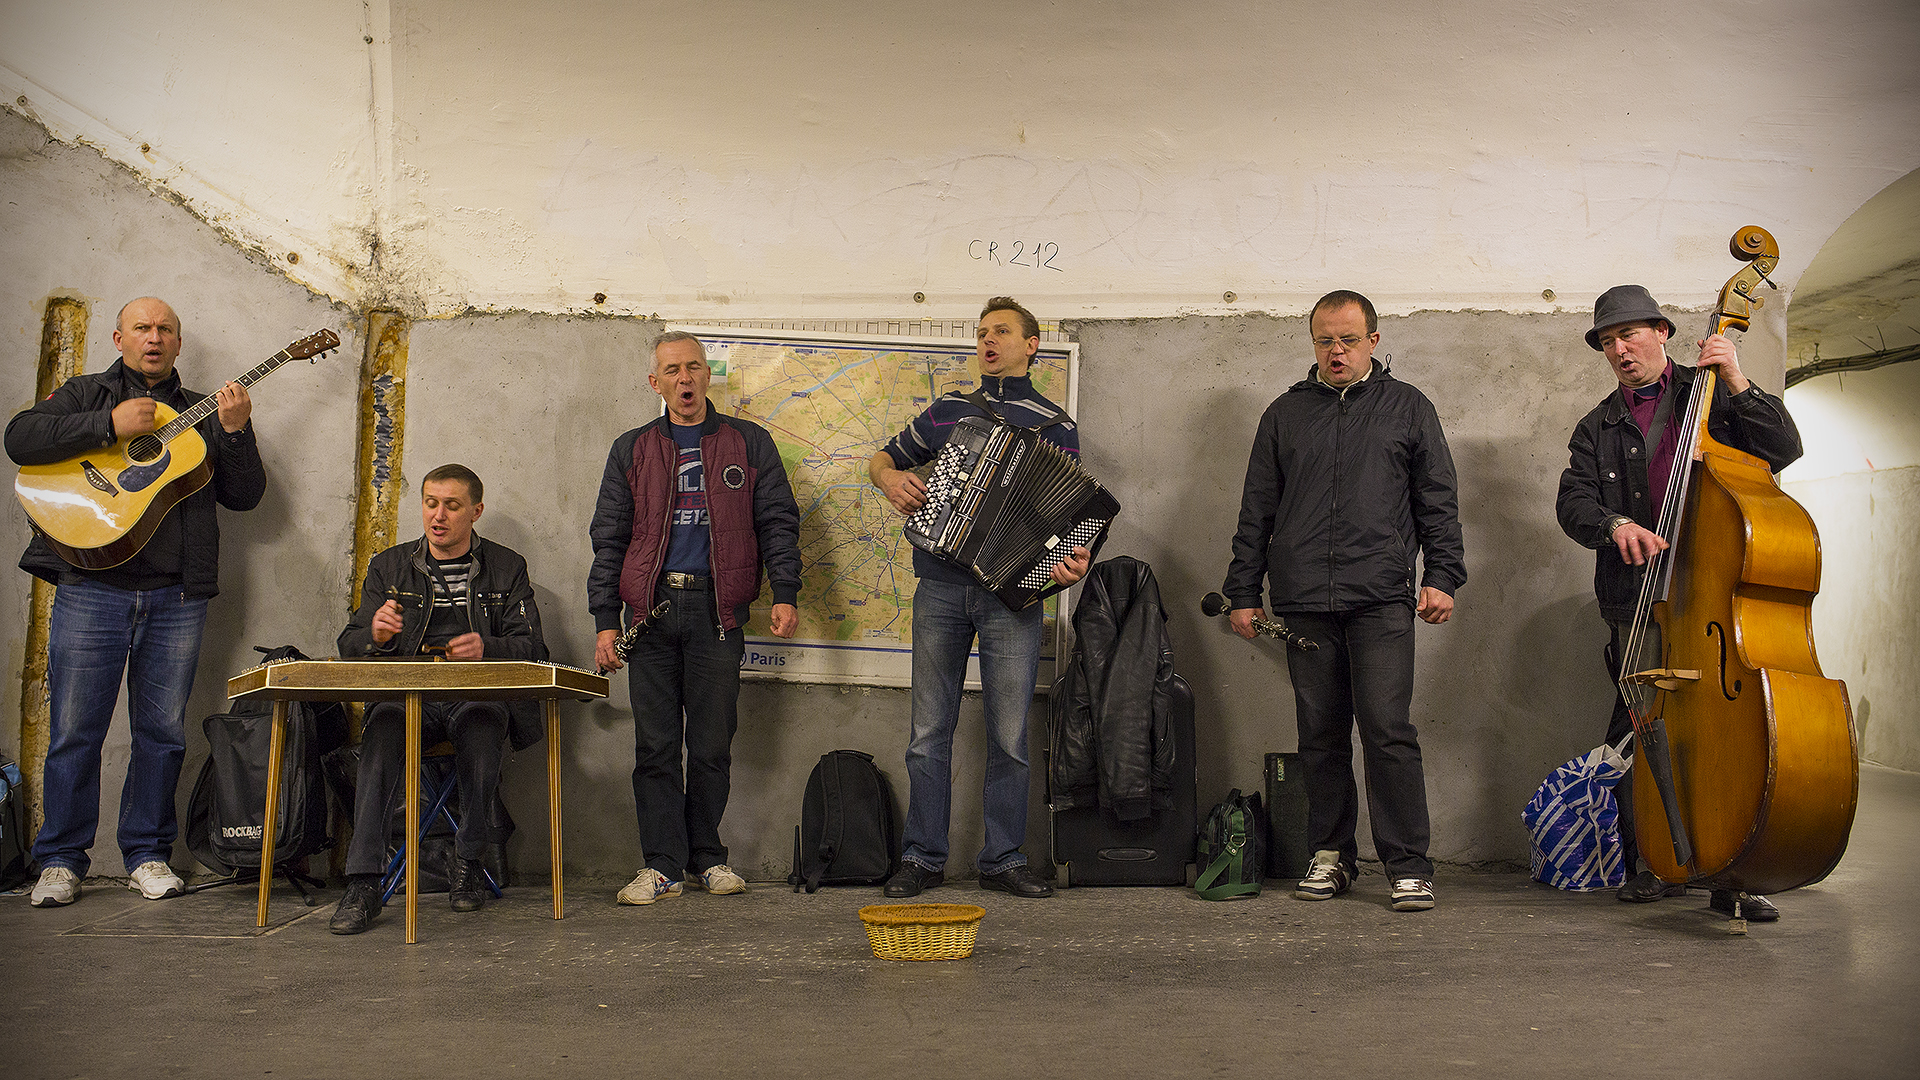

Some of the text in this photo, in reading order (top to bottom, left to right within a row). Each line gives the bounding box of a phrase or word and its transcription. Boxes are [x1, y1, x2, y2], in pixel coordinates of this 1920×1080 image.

[968, 239, 1064, 273] CR 212
[750, 652, 786, 667] Paris
[221, 825, 263, 838] ROCKBAG
